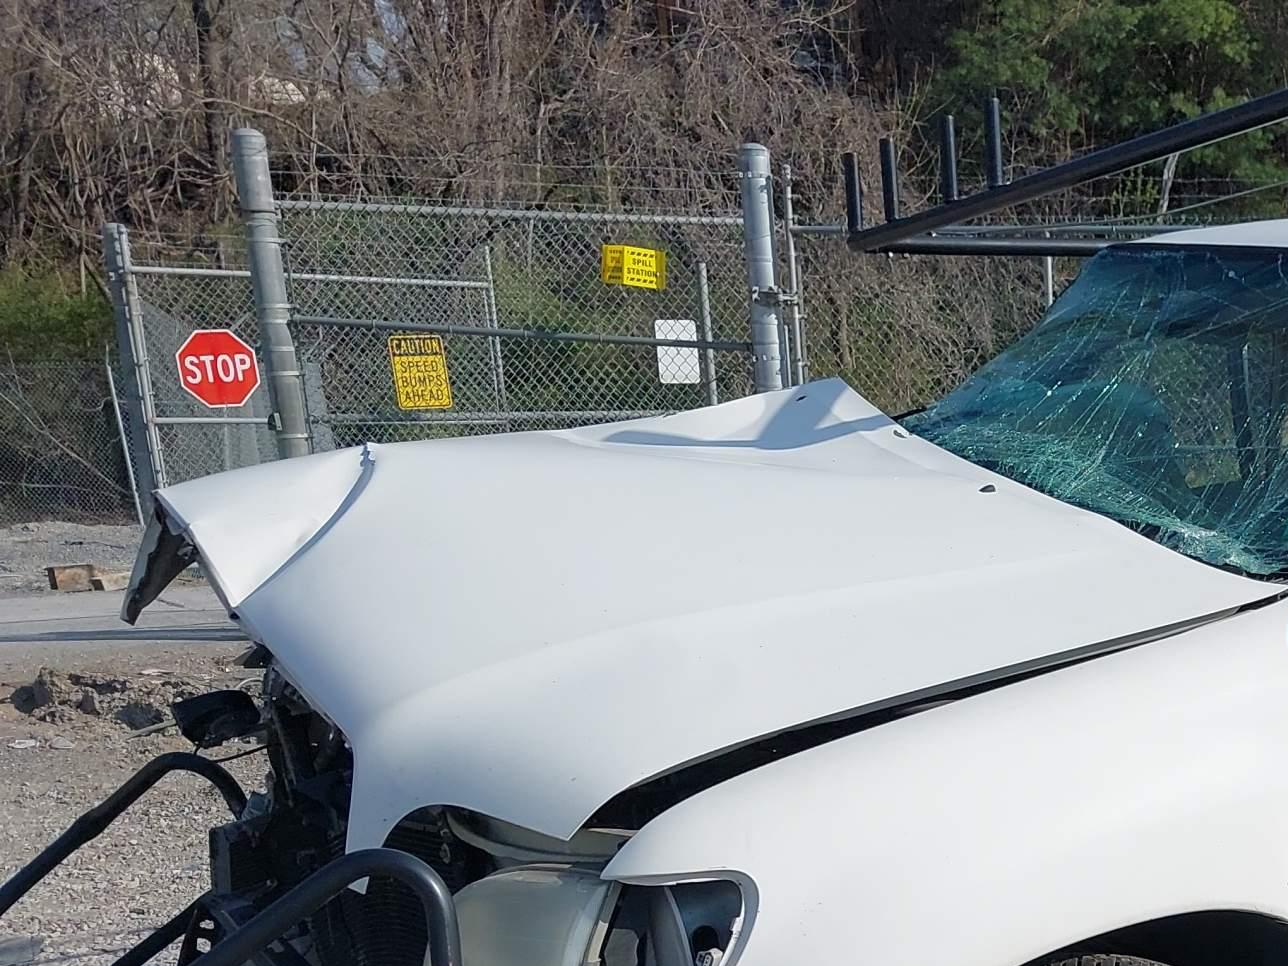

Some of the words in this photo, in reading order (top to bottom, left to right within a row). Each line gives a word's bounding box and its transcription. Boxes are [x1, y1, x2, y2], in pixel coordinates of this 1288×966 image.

[631, 258, 653, 267] SPILL
[626, 267, 658, 278] STATION
[393, 339, 440, 354] CAUTION
[184, 353, 251, 384] STOP
[400, 361, 439, 373] SPEED
[401, 375, 443, 388] BUMPS
[405, 388, 444, 402] AHEAD
